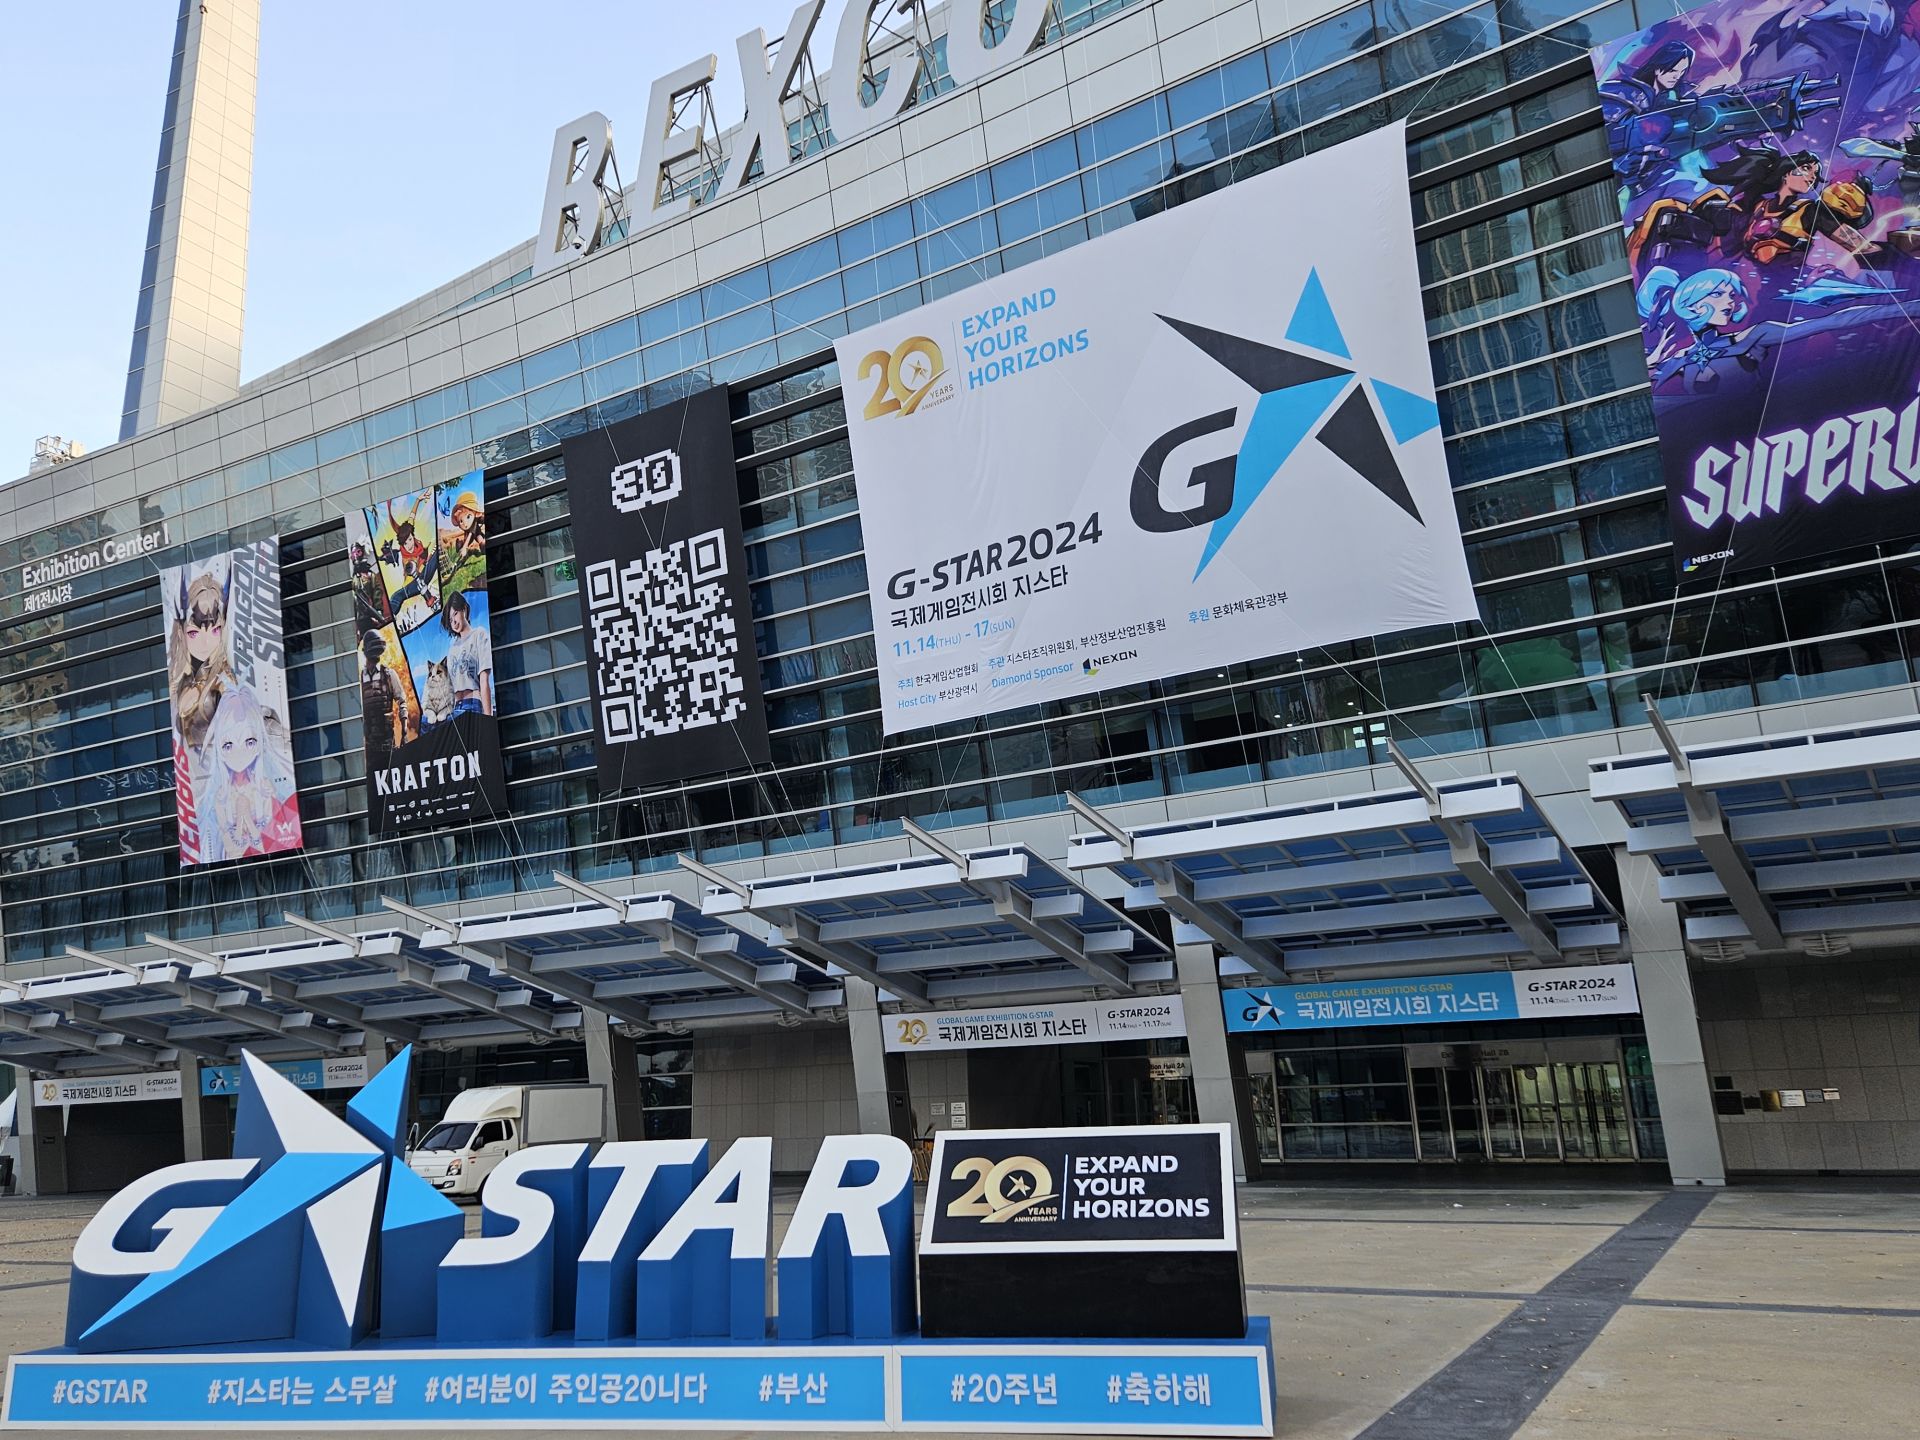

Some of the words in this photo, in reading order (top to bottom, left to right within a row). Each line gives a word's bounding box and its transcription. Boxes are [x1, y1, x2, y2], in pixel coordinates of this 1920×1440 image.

[961, 287, 1057, 339] EXPAND
[963, 324, 1028, 363] YOUR
[968, 329, 1089, 391] HORIZONS
[930, 384, 954, 399] YEARS
[22, 550, 100, 588] Exhibition
[103, 530, 161, 563] Center
[1691, 548, 1735, 565] NEXON
[24, 583, 73, 612] 제1전시장
[890, 582, 1008, 629] 국제게임전시회
[1014, 565, 1069, 599] 지스타
[1188, 608, 1210, 623] 후원
[1212, 591, 1289, 619] 문화체육관광부
[988, 655, 1005, 669] 주관
[1080, 618, 1167, 648] 부산정보산업진흥원
[1093, 650, 1138, 667] NEXON
[898, 677, 914, 691] 주최
[915, 662, 979, 686] 한국게임산업협회
[991, 670, 1032, 689] Diamond
[1034, 662, 1074, 681] Sponsor
[898, 698, 918, 709] Host
[920, 694, 937, 705] City
[939, 683, 978, 701] 부산광역시
[374, 750, 482, 796] KRAFTON
[1295, 990, 1329, 1000] GLOBAL
[1332, 988, 1359, 998] GAME
[1362, 985, 1417, 996] EXHIBITION
[1420, 983, 1454, 993] G-STAR
[1296, 995, 1432, 1020] 국제게임전시회
[1437, 991, 1500, 1013] 지스타
[937, 1017, 964, 1025] GLOBAL
[965, 1015, 985, 1023] GAME
[987, 1013, 1028, 1022] EXHIBITION
[1029, 1010, 1055, 1019] G-STAR
[938, 1021, 1038, 1042] 국제게임전시회
[1043, 1018, 1087, 1037] 지스타
[115, 1084, 137, 1096] 지스타
[1074, 1155, 1179, 1175] EXPAND
[1073, 1177, 1146, 1197] YOUR
[1014, 1215, 1058, 1223] ANNIVERSARY
[1028, 1206, 1058, 1215] YEARS
[1073, 1198, 1210, 1219] HORIZONS
[52, 1378, 149, 1405] #GSTAR
[207, 1376, 315, 1406] #지스타는
[324, 1375, 398, 1405] 스무살
[424, 1373, 537, 1405] #여러분이
[548, 1373, 707, 1404] 주인공20니다
[758, 1373, 828, 1404] #부산
[950, 1372, 1058, 1406] #20주년
[1106, 1371, 1211, 1406] #축하해
